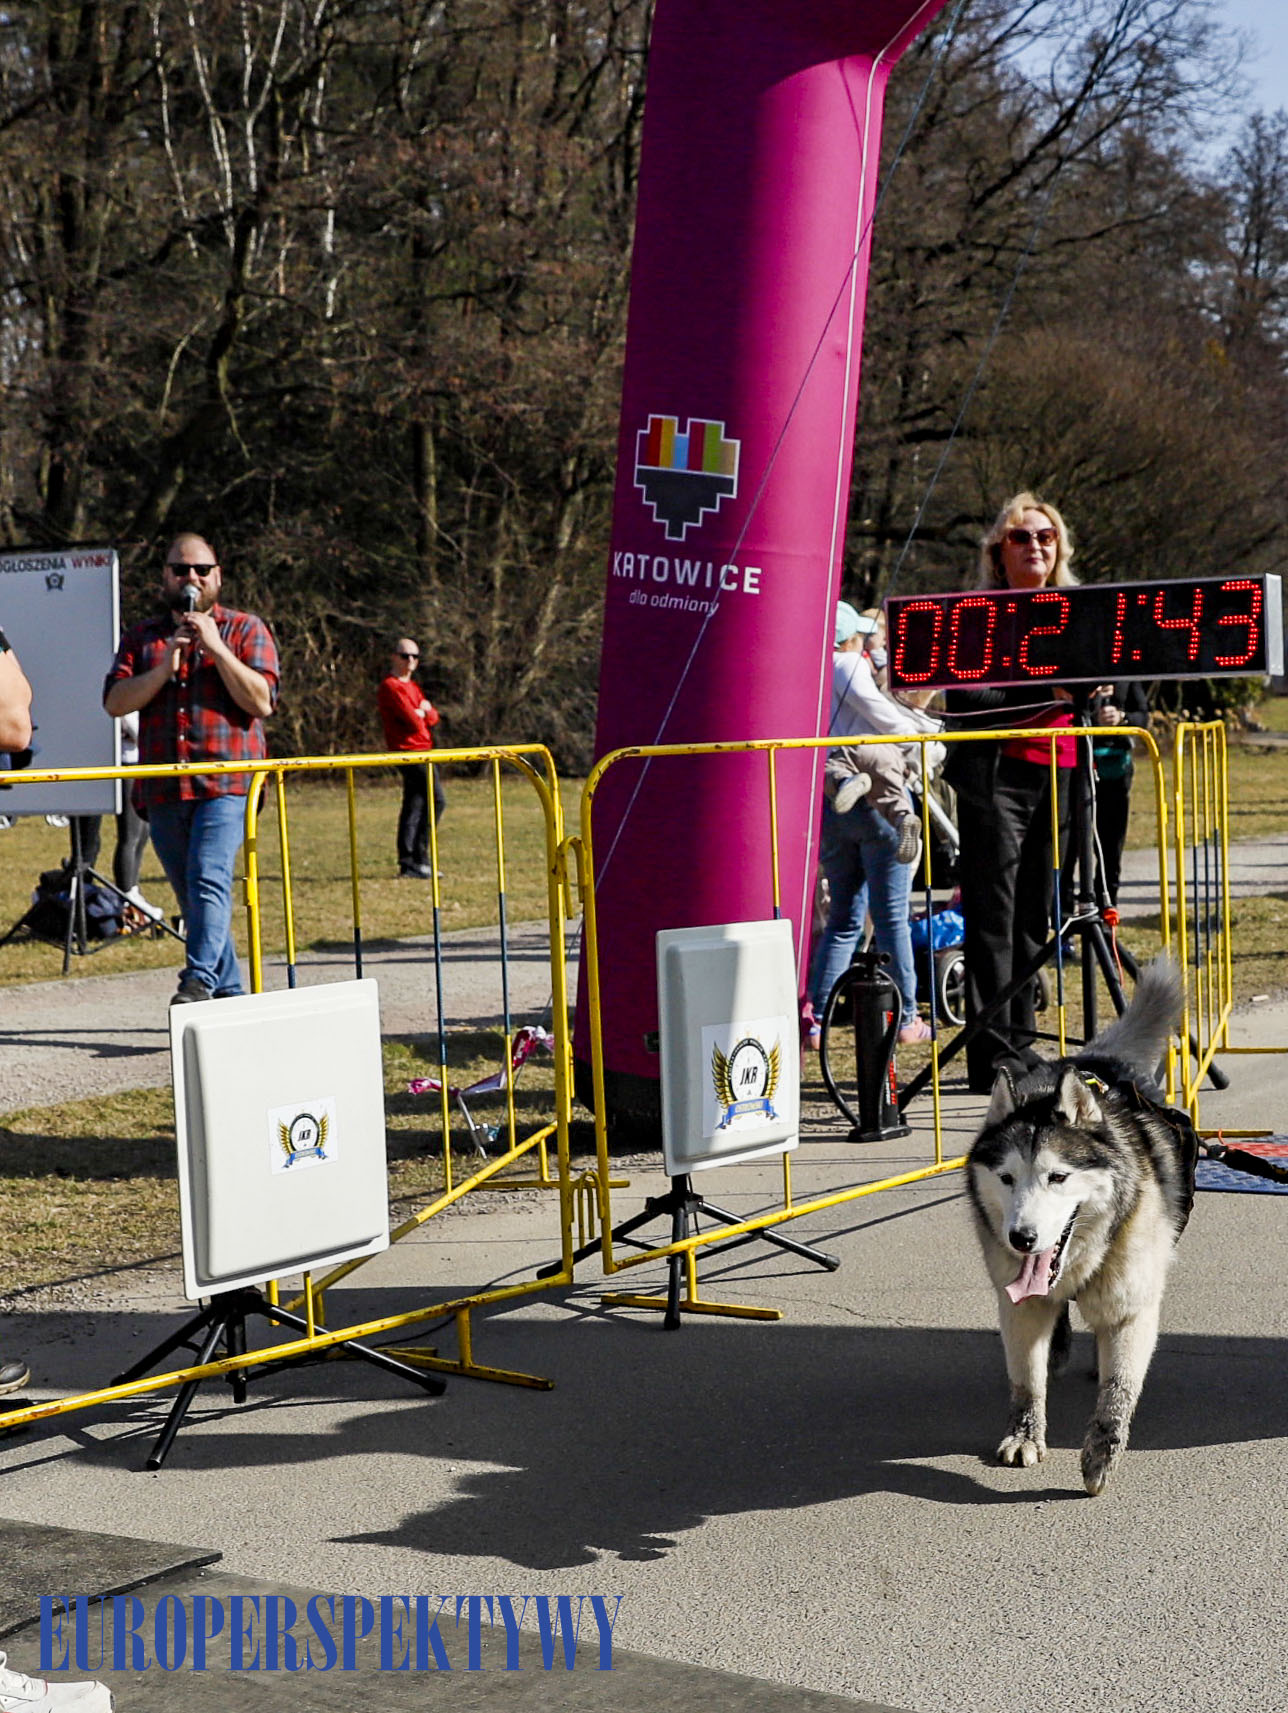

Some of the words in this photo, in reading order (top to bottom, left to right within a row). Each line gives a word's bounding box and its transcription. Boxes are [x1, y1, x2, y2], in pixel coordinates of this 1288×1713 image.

[613, 551, 762, 594] KATOWICE
[629, 590, 648, 605] dla
[650, 593, 720, 618] odmiany
[894, 579, 1263, 682] 00:21:43
[740, 1066, 758, 1085] JKR
